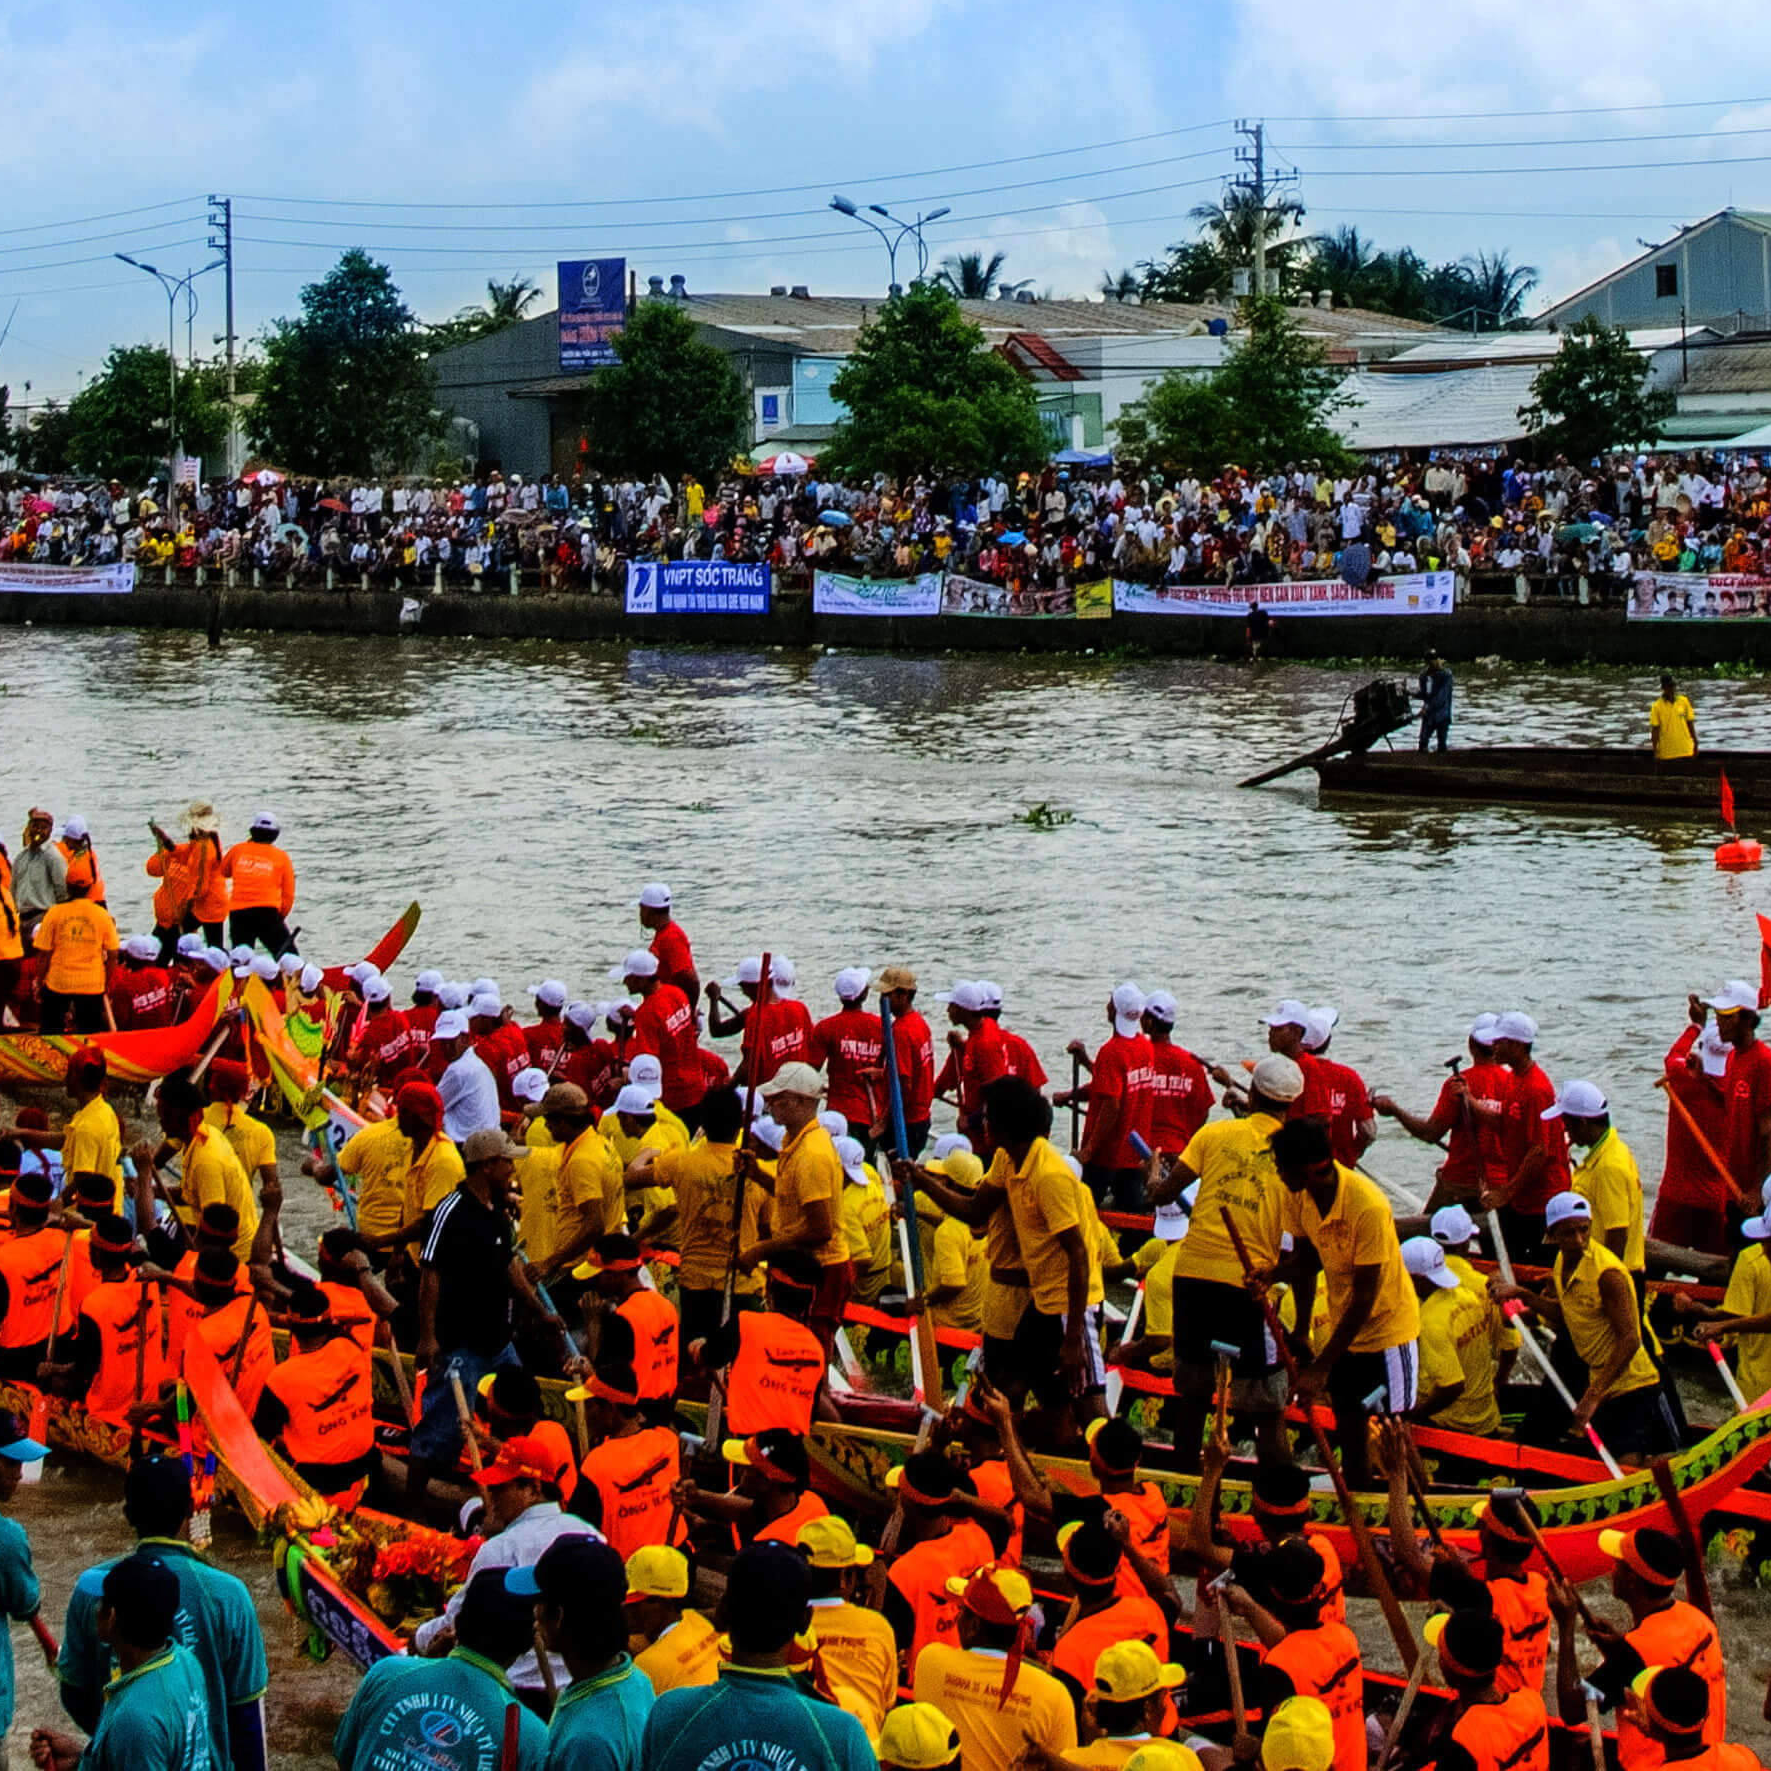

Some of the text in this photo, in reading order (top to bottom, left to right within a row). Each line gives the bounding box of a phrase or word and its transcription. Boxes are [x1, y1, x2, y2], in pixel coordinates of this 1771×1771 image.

[664, 567, 694, 586] VNPT
[695, 563, 720, 586] SÓC
[395, 1692, 429, 1715] TNHH
